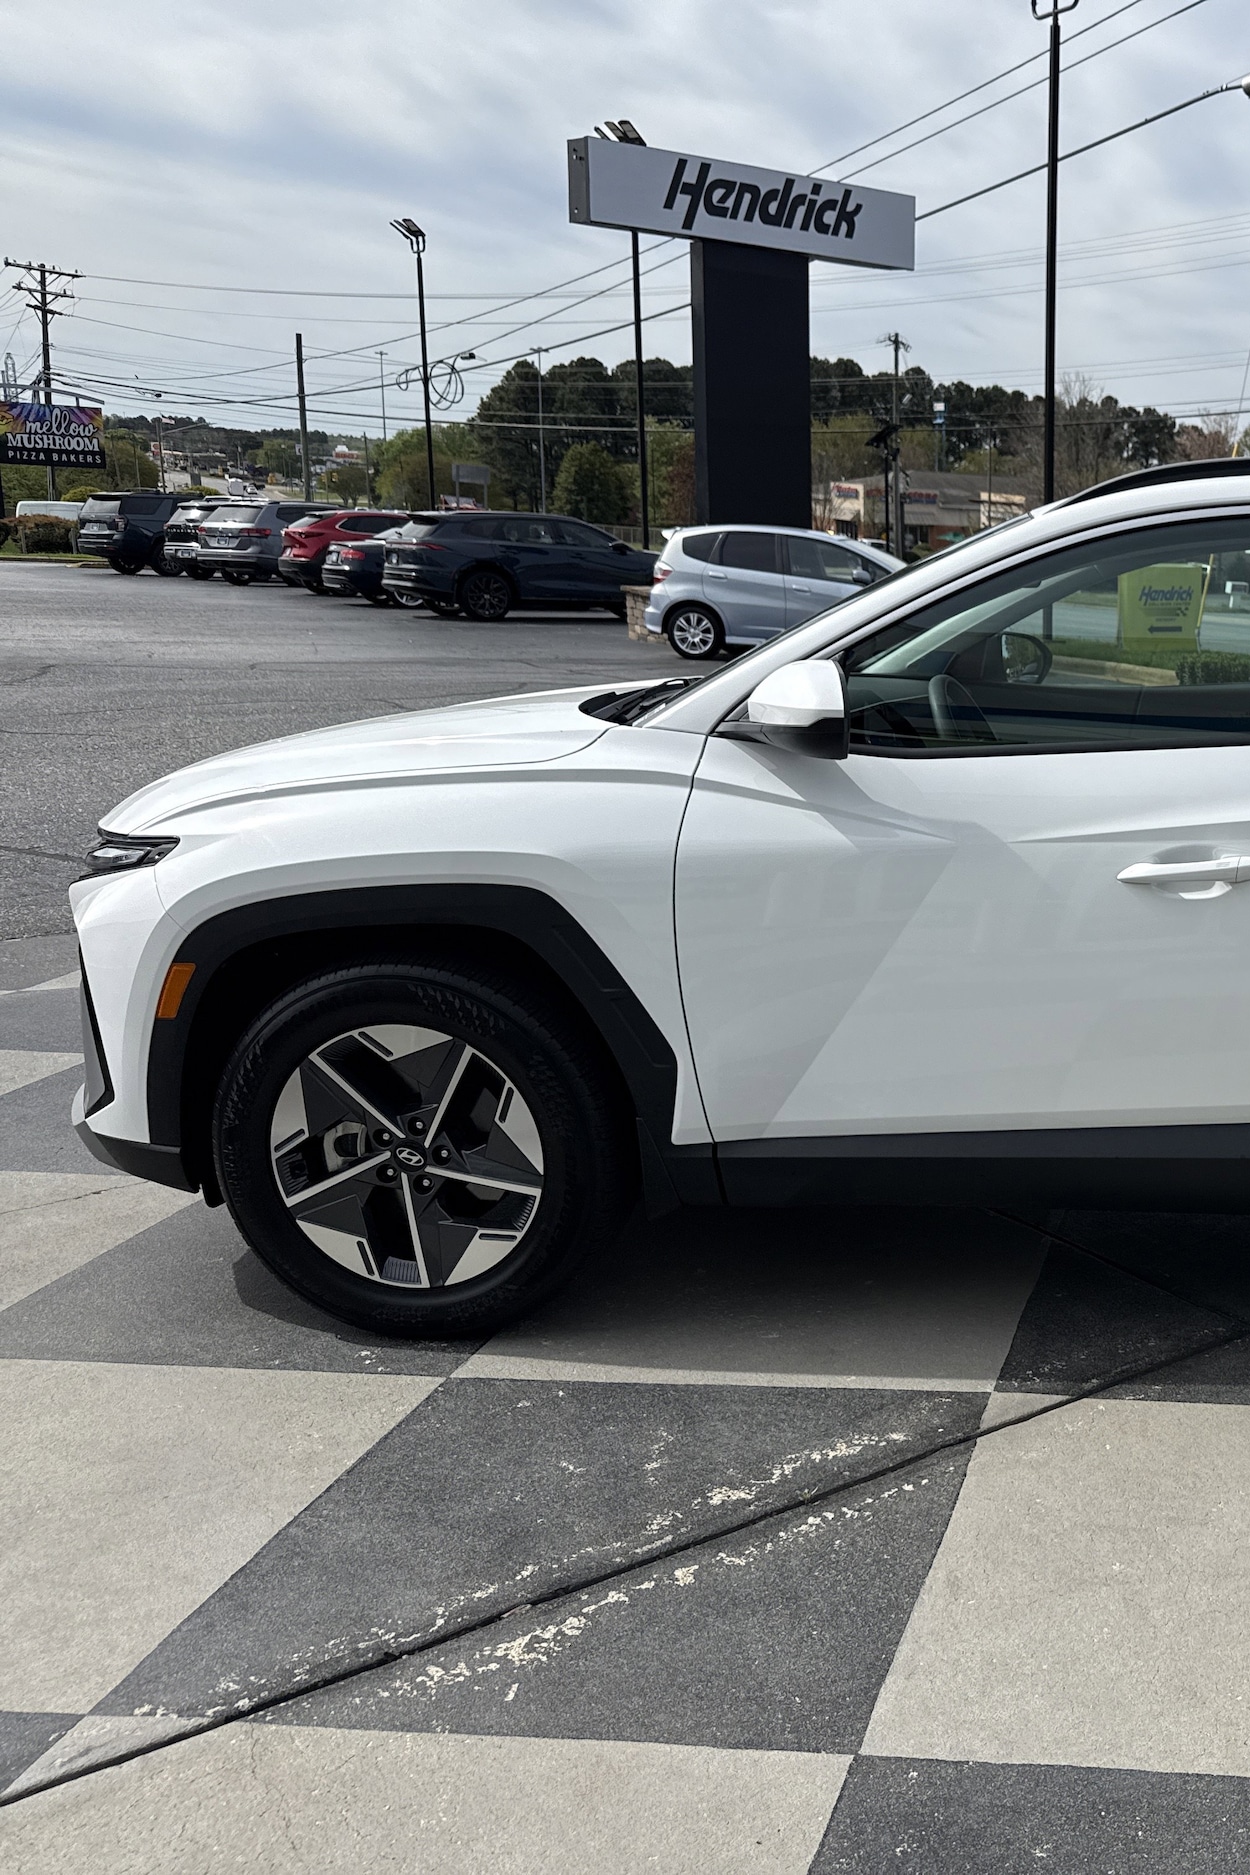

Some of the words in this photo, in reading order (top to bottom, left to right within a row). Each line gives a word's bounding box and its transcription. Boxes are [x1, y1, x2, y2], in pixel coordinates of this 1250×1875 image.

[663, 158, 863, 239] Hendrick
[26, 408, 97, 436] mellow
[7, 433, 99, 451] MUSHROOM
[8, 450, 45, 460] PIZZA
[52, 453, 101, 463] BAKERS
[1139, 586, 1193, 606] Hendrick
